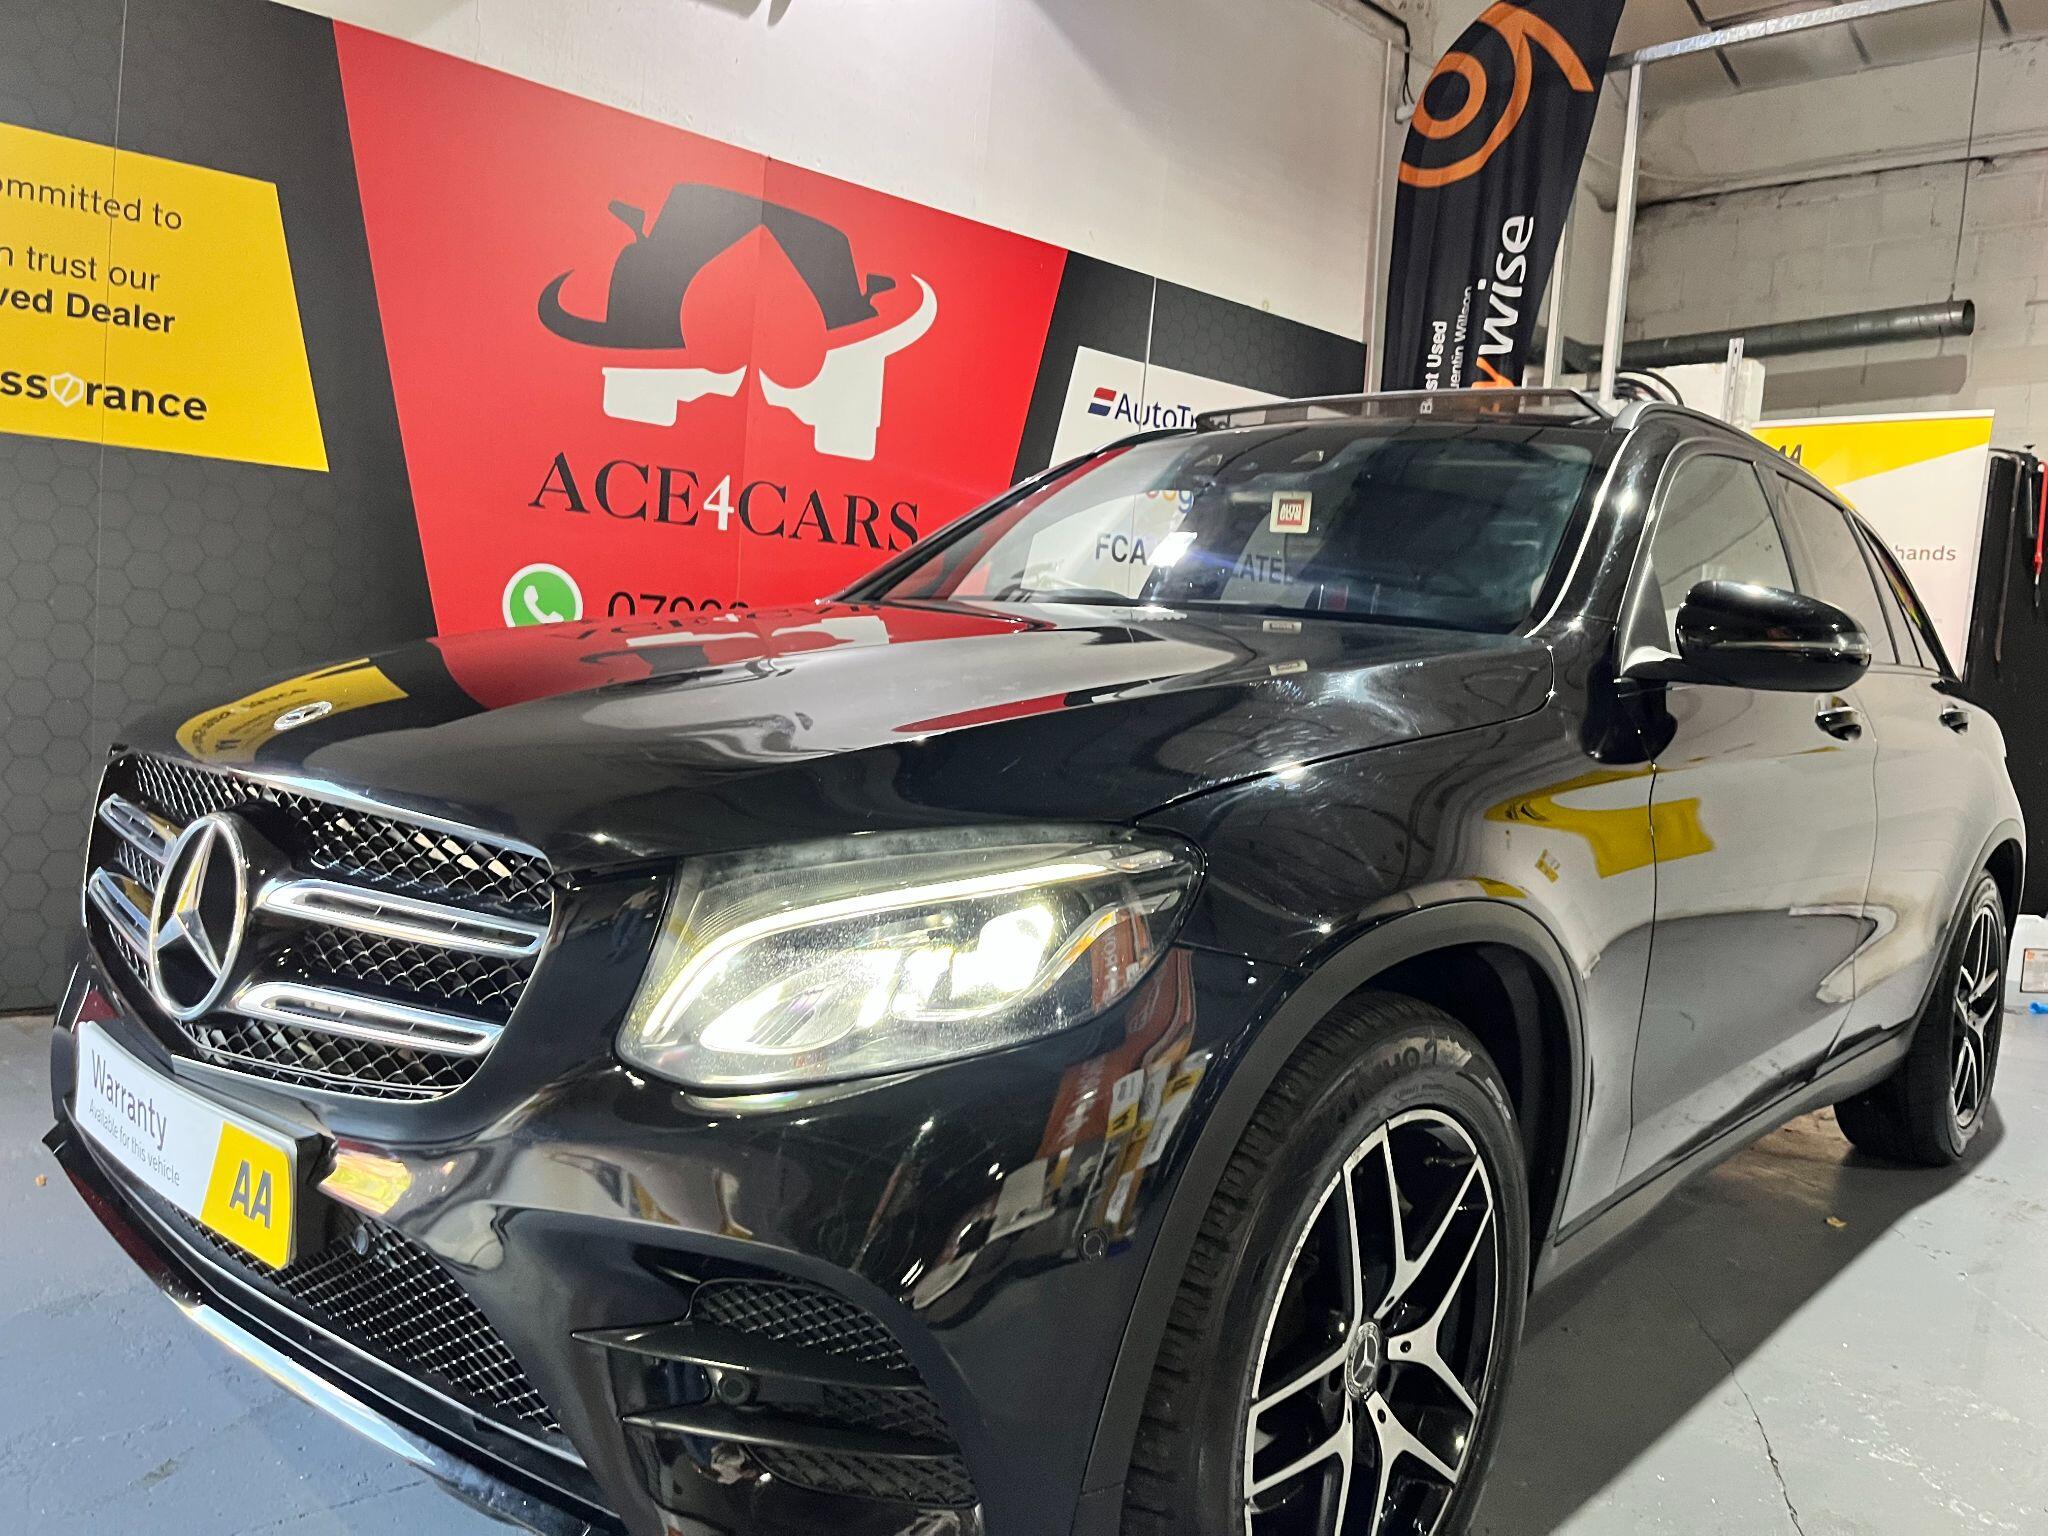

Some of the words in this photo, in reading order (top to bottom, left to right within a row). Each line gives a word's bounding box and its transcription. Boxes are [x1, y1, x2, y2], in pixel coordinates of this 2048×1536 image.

[0, 178, 142, 223] mmitted
[153, 202, 182, 229] to
[27, 246, 98, 281] trust
[109, 266, 161, 292] our
[67, 292, 176, 334] Dealer
[1454, 286, 1472, 342] Wilson
[1426, 321, 1448, 368] Used
[1420, 372, 1440, 415] Bst
[528, 451, 919, 552] ACE4CARS
[1095, 533, 1147, 566] FCA
[1895, 545, 1957, 561] hands
[91, 1048, 167, 1151] Warranty
[132, 1136, 146, 1162] this
[148, 1152, 180, 1186] vehicle
[229, 1160, 272, 1229] AA
